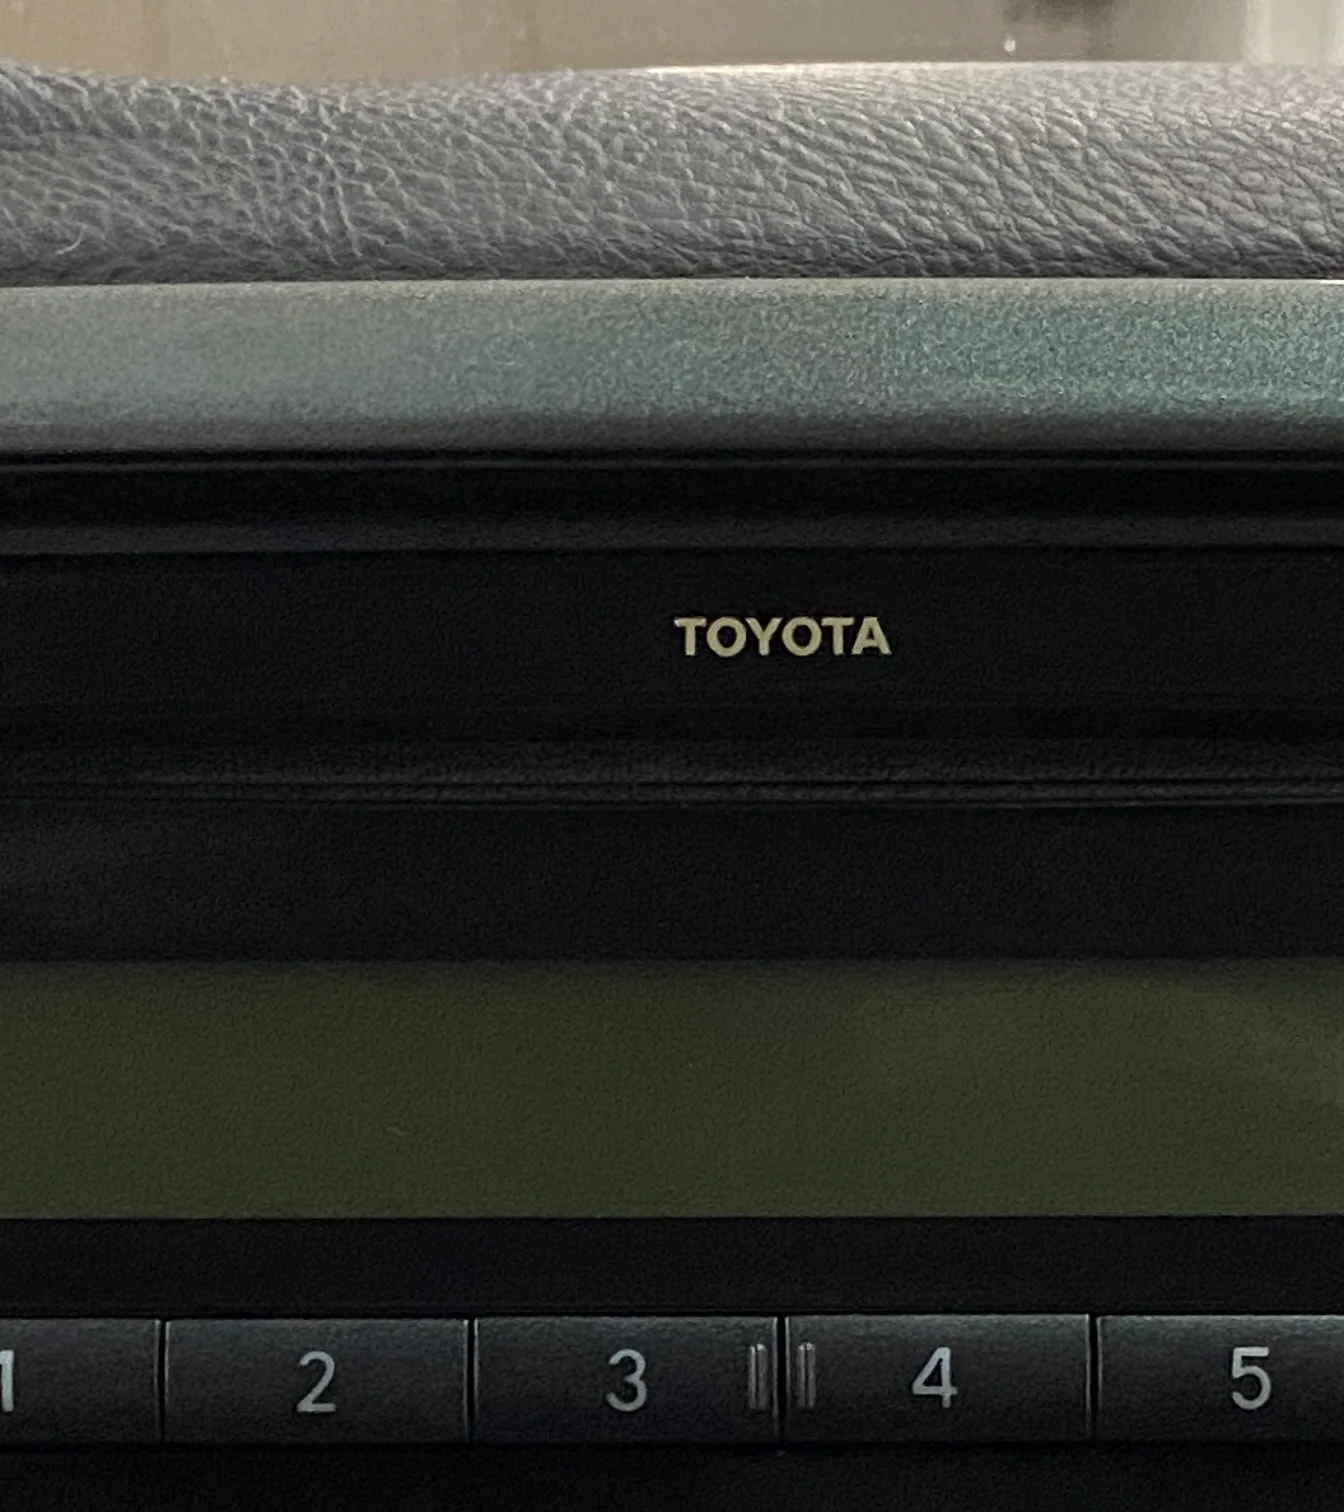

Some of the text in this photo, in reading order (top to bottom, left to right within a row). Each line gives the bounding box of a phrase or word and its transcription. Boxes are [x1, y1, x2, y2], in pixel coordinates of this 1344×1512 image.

[674, 616, 892, 657] TOYOTA
[296, 1351, 337, 1413] 2
[606, 1348, 648, 1412] 3
[911, 1347, 958, 1408] 4
[1231, 1347, 1272, 1409] 5
